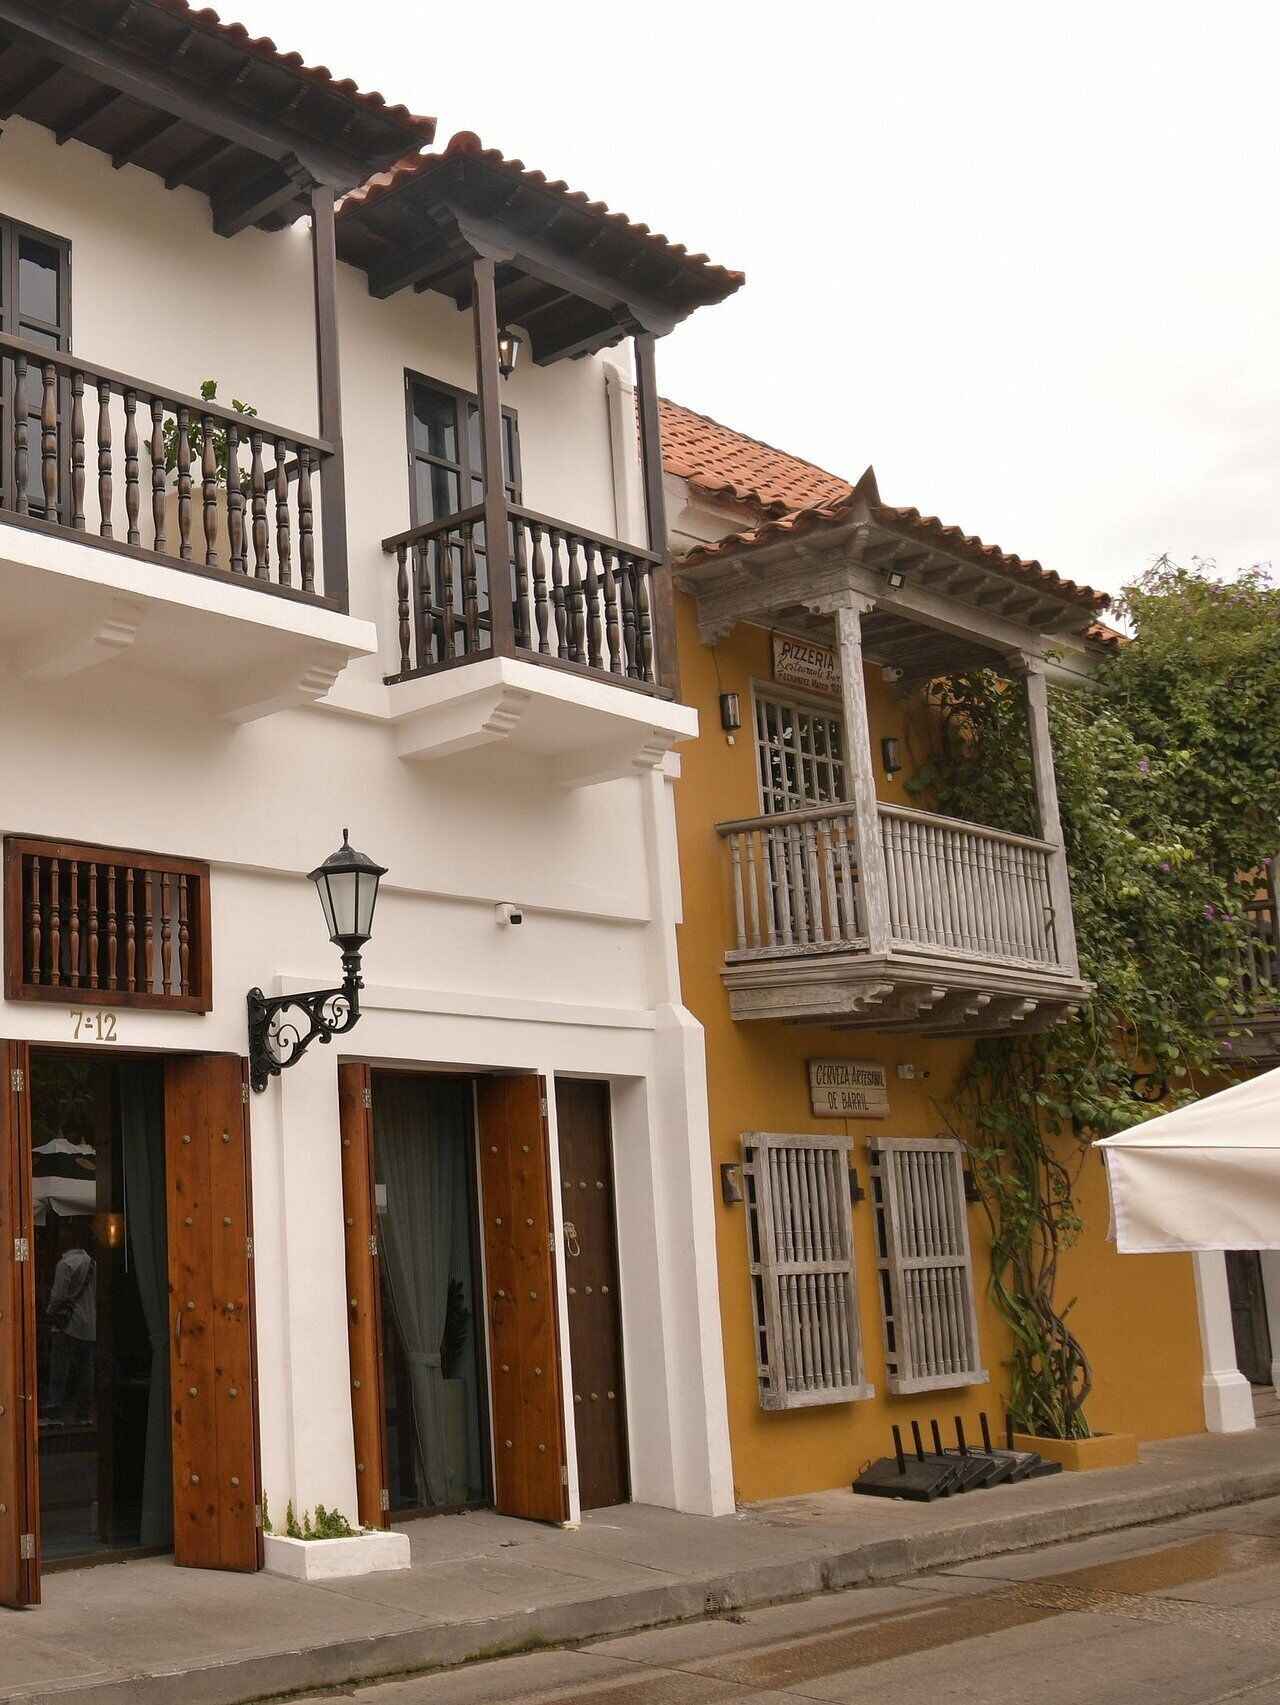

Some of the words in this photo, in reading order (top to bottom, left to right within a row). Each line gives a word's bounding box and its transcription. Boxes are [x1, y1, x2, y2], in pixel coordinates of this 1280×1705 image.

[781, 641, 835, 671] PIZZERIA
[816, 1064, 850, 1086] CERVEZA
[828, 1091, 839, 1110] DE
[841, 1092, 869, 1111] BARRIL
